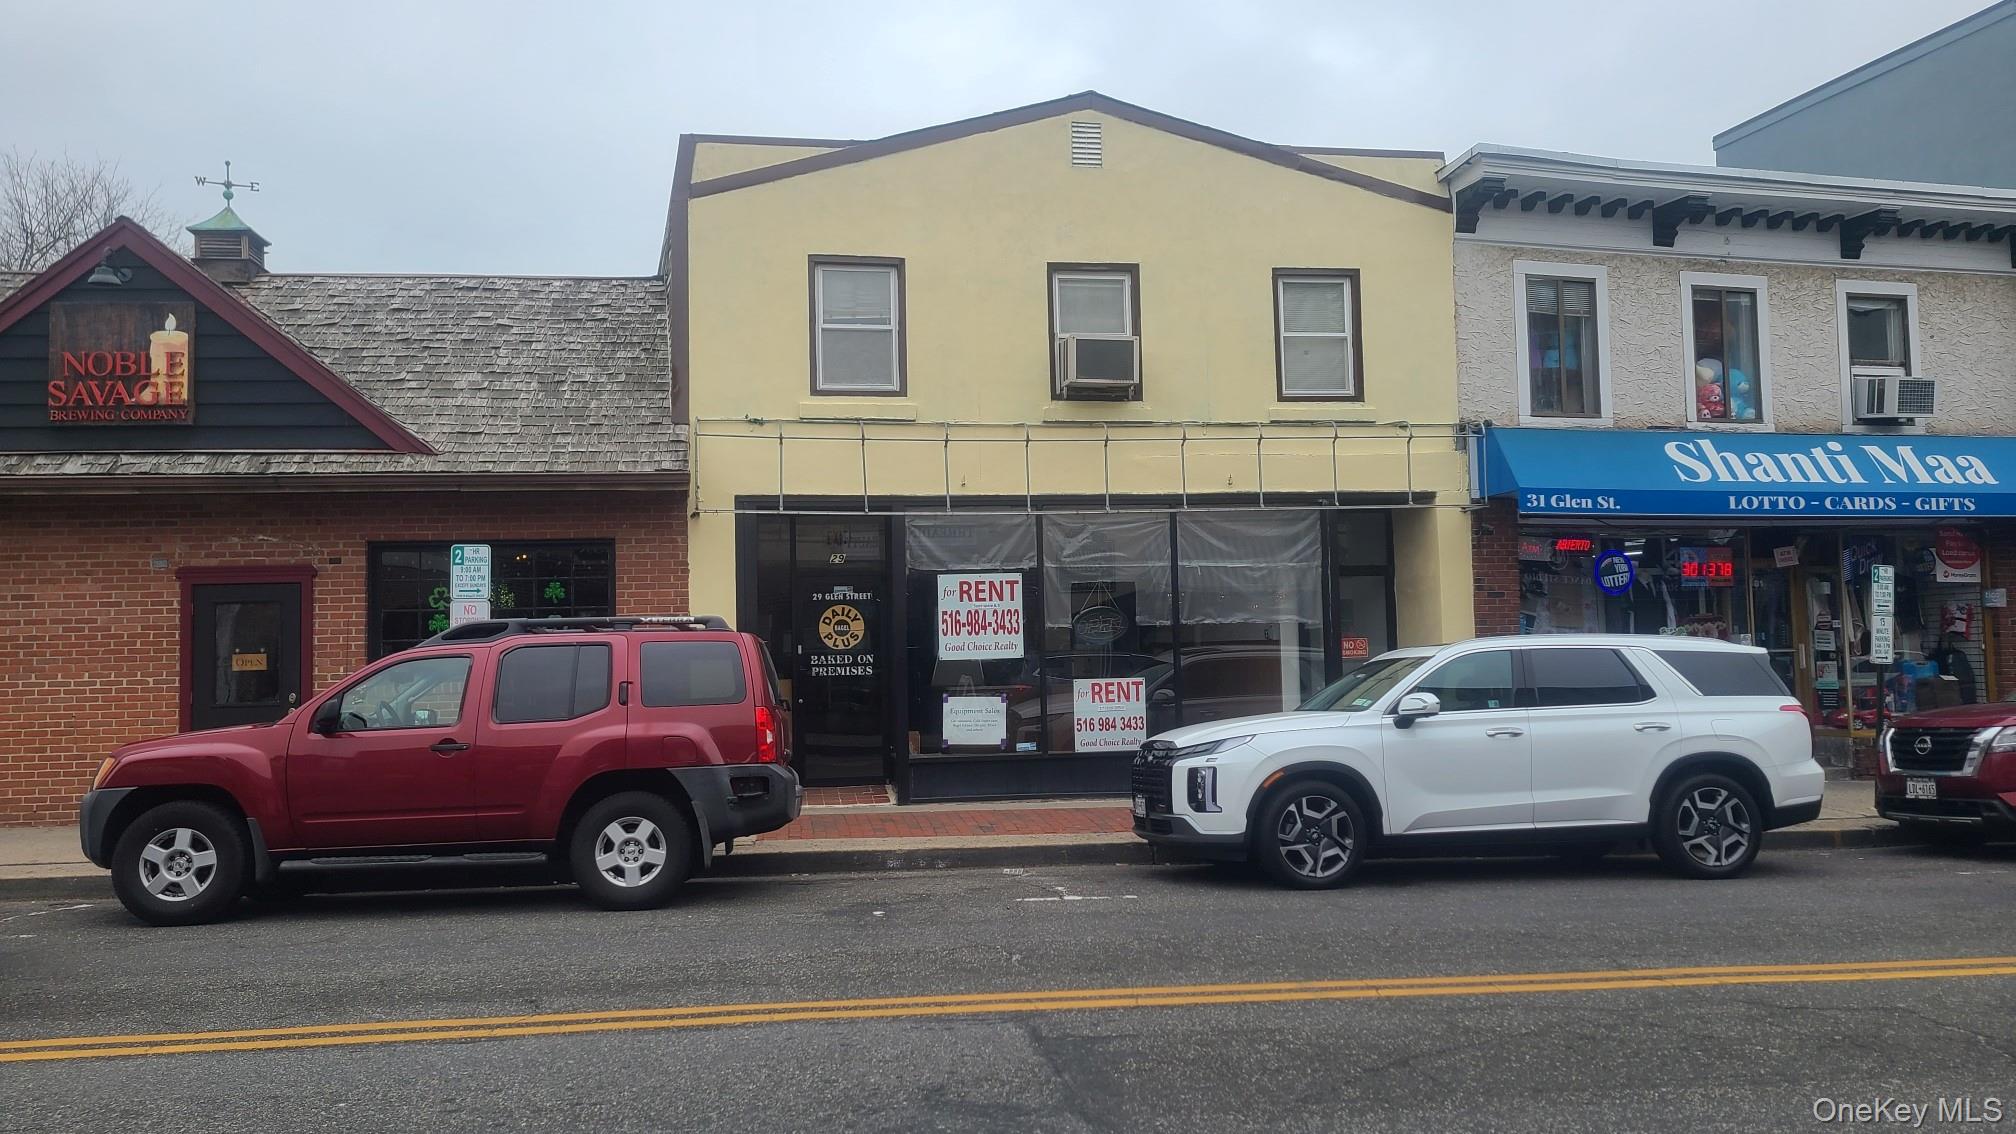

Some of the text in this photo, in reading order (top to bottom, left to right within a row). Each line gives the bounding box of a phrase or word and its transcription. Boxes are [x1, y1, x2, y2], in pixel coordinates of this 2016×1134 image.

[194, 176, 206, 186] W
[250, 182, 260, 192] E
[62, 351, 186, 376] NOBLE
[47, 380, 187, 406] SAVAGE
[50, 408, 189, 421] BREWING COMPANY
[1664, 439, 1999, 485] Shanti Maa
[1526, 494, 1621, 510] 31 Glen St.
[1728, 495, 1806, 510] LOTTO
[1824, 496, 1897, 511] CARDS
[1914, 497, 1976, 511] GIFTS
[1556, 540, 1591, 550] ABIERTO
[454, 550, 462, 564] 2
[830, 554, 845, 563] 29
[1601, 573, 1630, 587] LOTTERY
[1873, 568, 1879, 582] 2
[941, 579, 1020, 602] for RENT
[463, 605, 477, 615] NO
[821, 607, 861, 627] DAILY
[941, 608, 1020, 637] 516-984-3433
[823, 631, 860, 648] PLUS
[944, 641, 1018, 652] Good Choice Realty
[1343, 641, 1355, 649] NO
[235, 657, 263, 667] OPEN
[810, 654, 874, 665] BAKED ON
[812, 666, 873, 676] PREMISES
[1076, 681, 1143, 703] for RENT
[1076, 716, 1145, 732] 516 984 3433
[1080, 737, 1141, 748] Good Choice Realty
